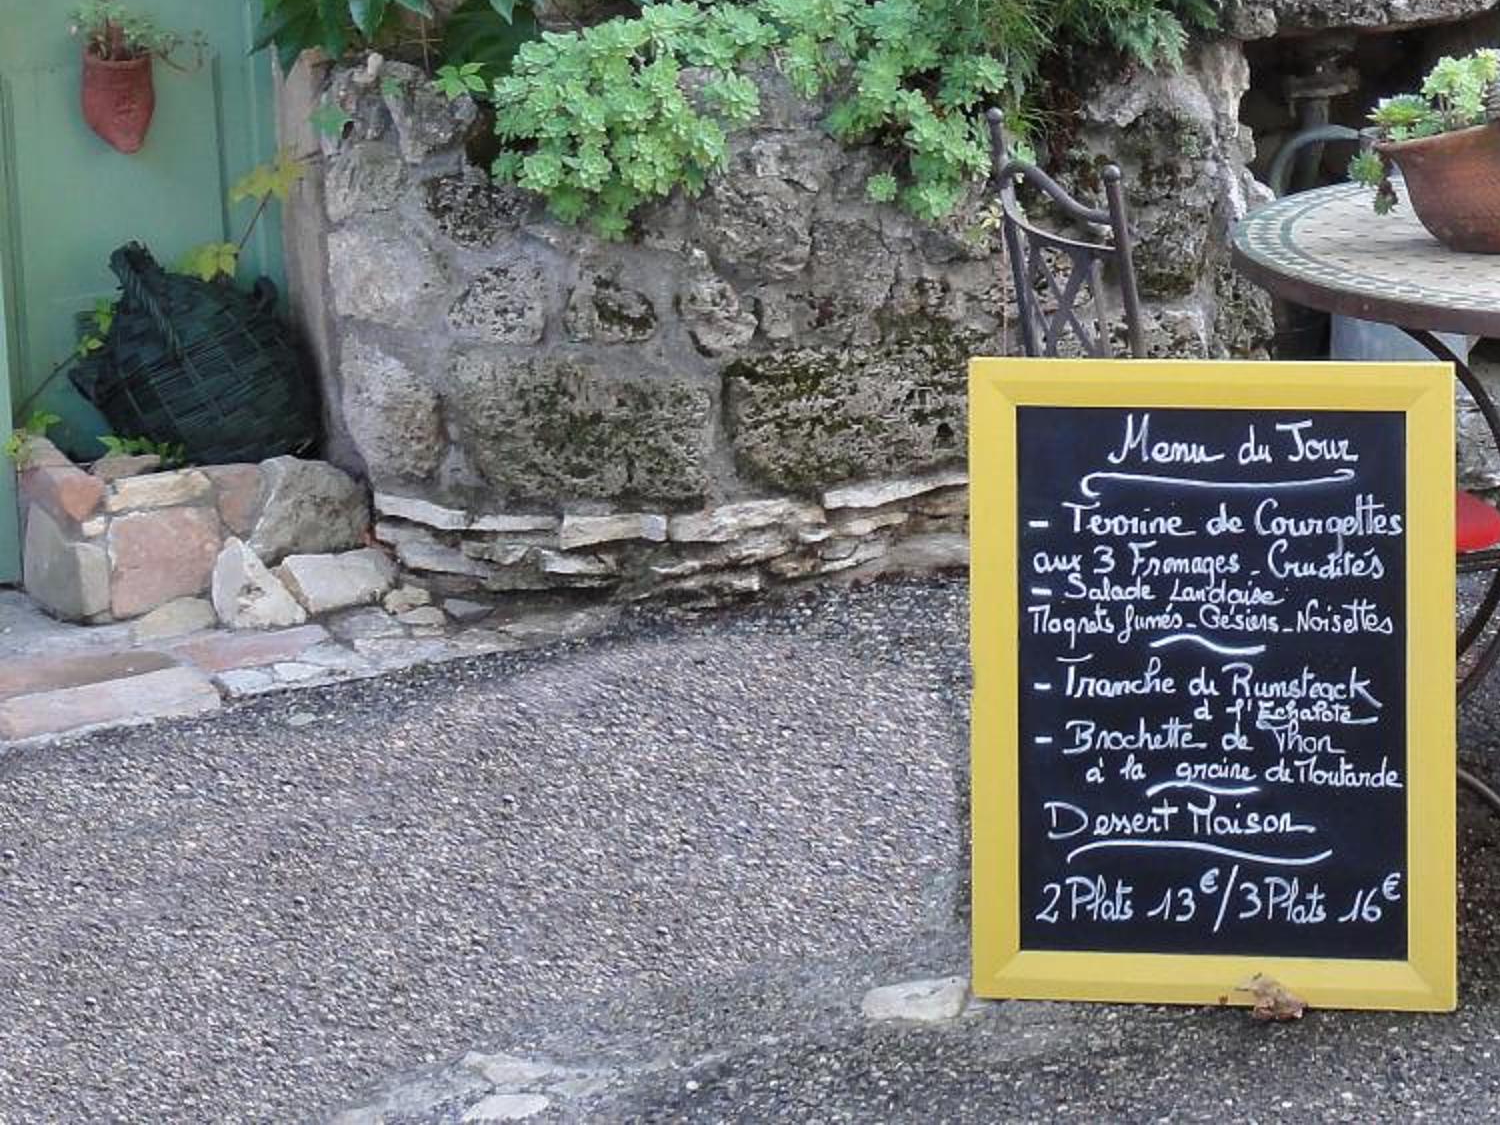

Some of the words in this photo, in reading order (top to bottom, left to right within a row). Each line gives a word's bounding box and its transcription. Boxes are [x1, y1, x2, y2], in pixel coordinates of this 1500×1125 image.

[1107, 413, 1224, 465] Menu
[1238, 424, 1273, 465] du
[1276, 419, 1358, 463] Jour
[1206, 503, 1246, 535] de
[1255, 494, 1404, 558] Courgettes
[1033, 552, 1082, 572] aux
[1093, 545, 1115, 574] 3
[1128, 540, 1241, 590] Fromages
[1267, 539, 1385, 581] Crudités
[1064, 573, 1156, 602] Salade
[1169, 577, 1286, 606] Landaise
[1296, 598, 1394, 635] Noisettes
[1056, 653, 1176, 699] Tranche
[1062, 717, 1208, 755] Brochette
[1222, 720, 1254, 751] de
[1274, 720, 1346, 755] Thon
[1119, 756, 1147, 781] la
[1175, 758, 1257, 784] graine
[1043, 798, 1179, 839] Dessert
[1187, 794, 1317, 836] Maison
